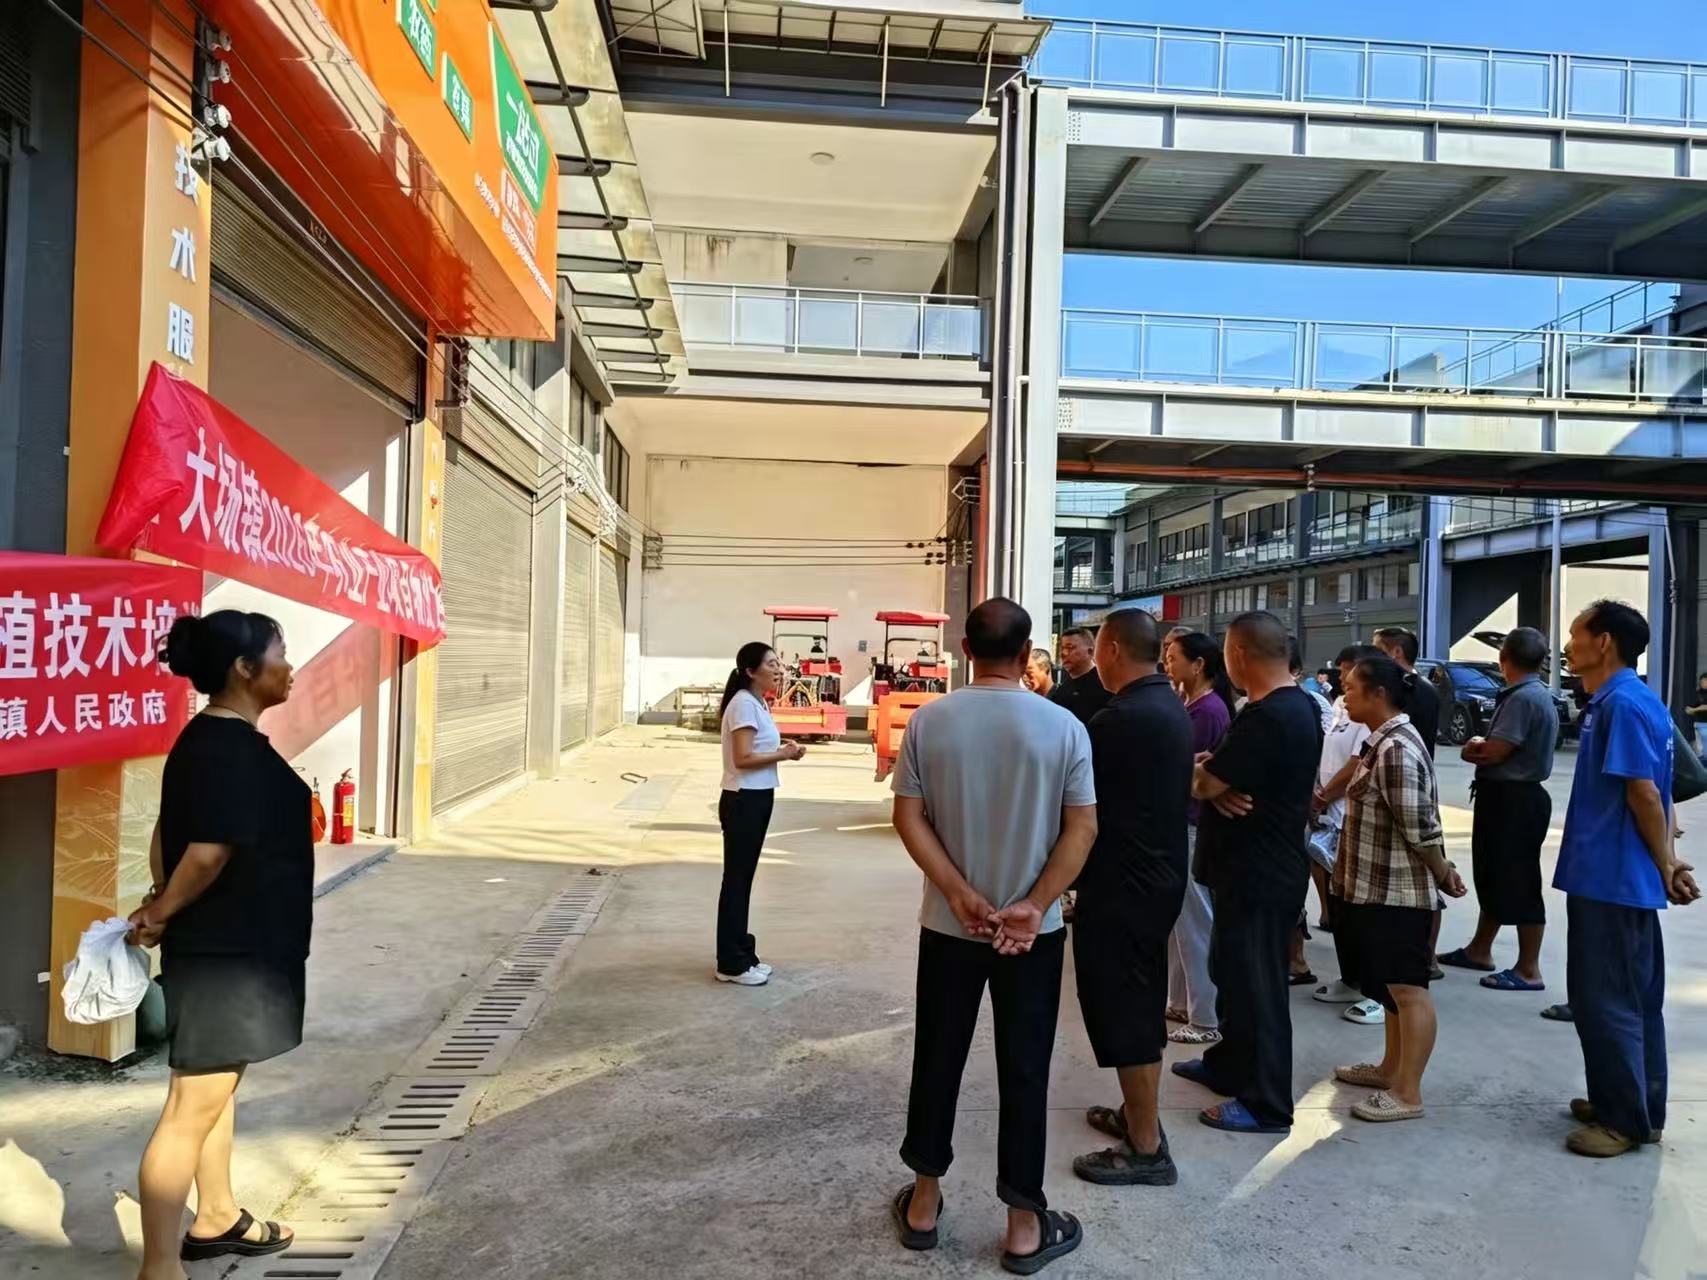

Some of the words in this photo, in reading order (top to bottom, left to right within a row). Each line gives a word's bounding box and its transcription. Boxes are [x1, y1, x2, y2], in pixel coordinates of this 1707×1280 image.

[0, 590, 200, 679] 植技术培
[0, 689, 167, 740] 镇人民政府
